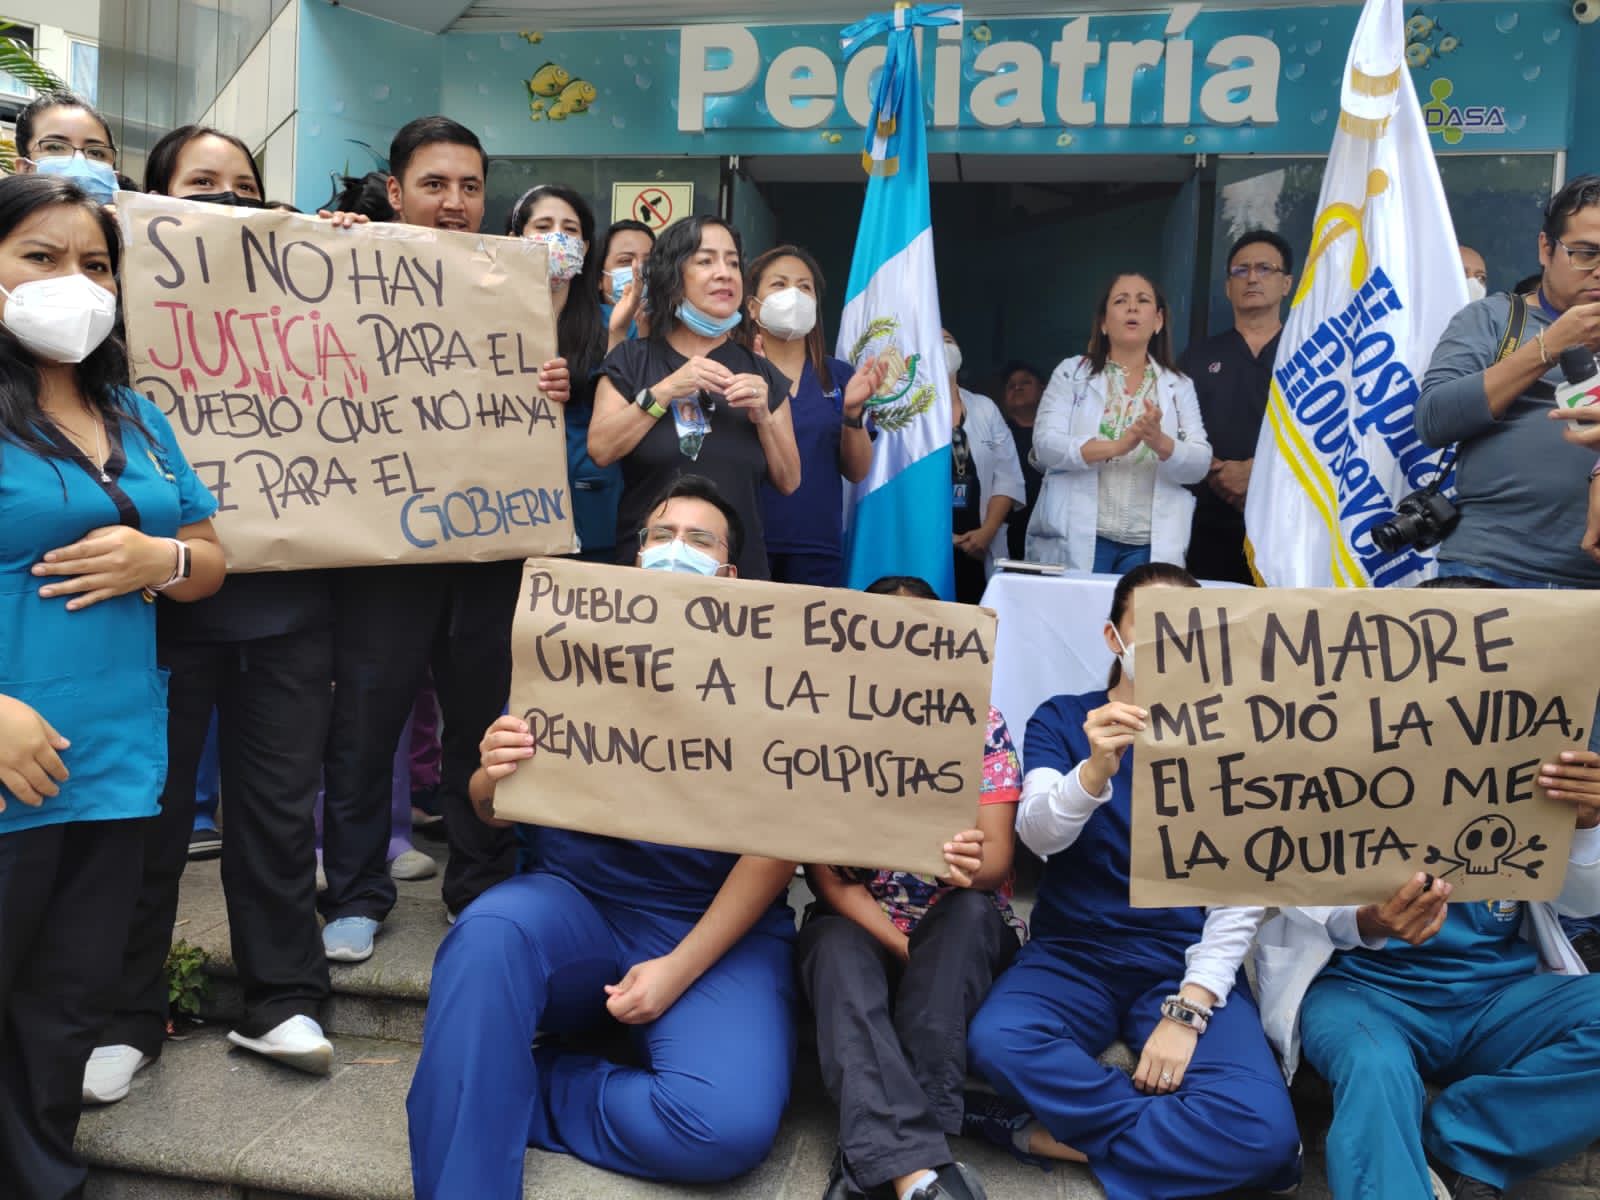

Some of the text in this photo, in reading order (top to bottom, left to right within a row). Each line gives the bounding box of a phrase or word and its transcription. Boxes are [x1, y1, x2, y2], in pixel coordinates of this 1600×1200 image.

[1424, 108, 1504, 126] DASA
[147, 216, 445, 307] SI NO HAY
[357, 313, 476, 376] PARA
[488, 332, 538, 376] EL
[135, 376, 557, 443] PUEBLO QUE NO HAYA
[1328, 266, 1457, 504] Hospita
[234, 449, 357, 519] PARA
[371, 452, 435, 496] EL
[529, 571, 989, 664] PUEBLO QUE ESCUCHA
[1154, 607, 1514, 686] MI MADRE
[536, 622, 977, 726] ÚNETE A LA LUCHA
[524, 707, 964, 797] RENUNCIEN GOLPISTAS
[1150, 690, 1585, 753] ME DIÓ LA VIDA,
[1443, 758, 1541, 806] ME
[1158, 825, 1417, 882] LA QUITA
